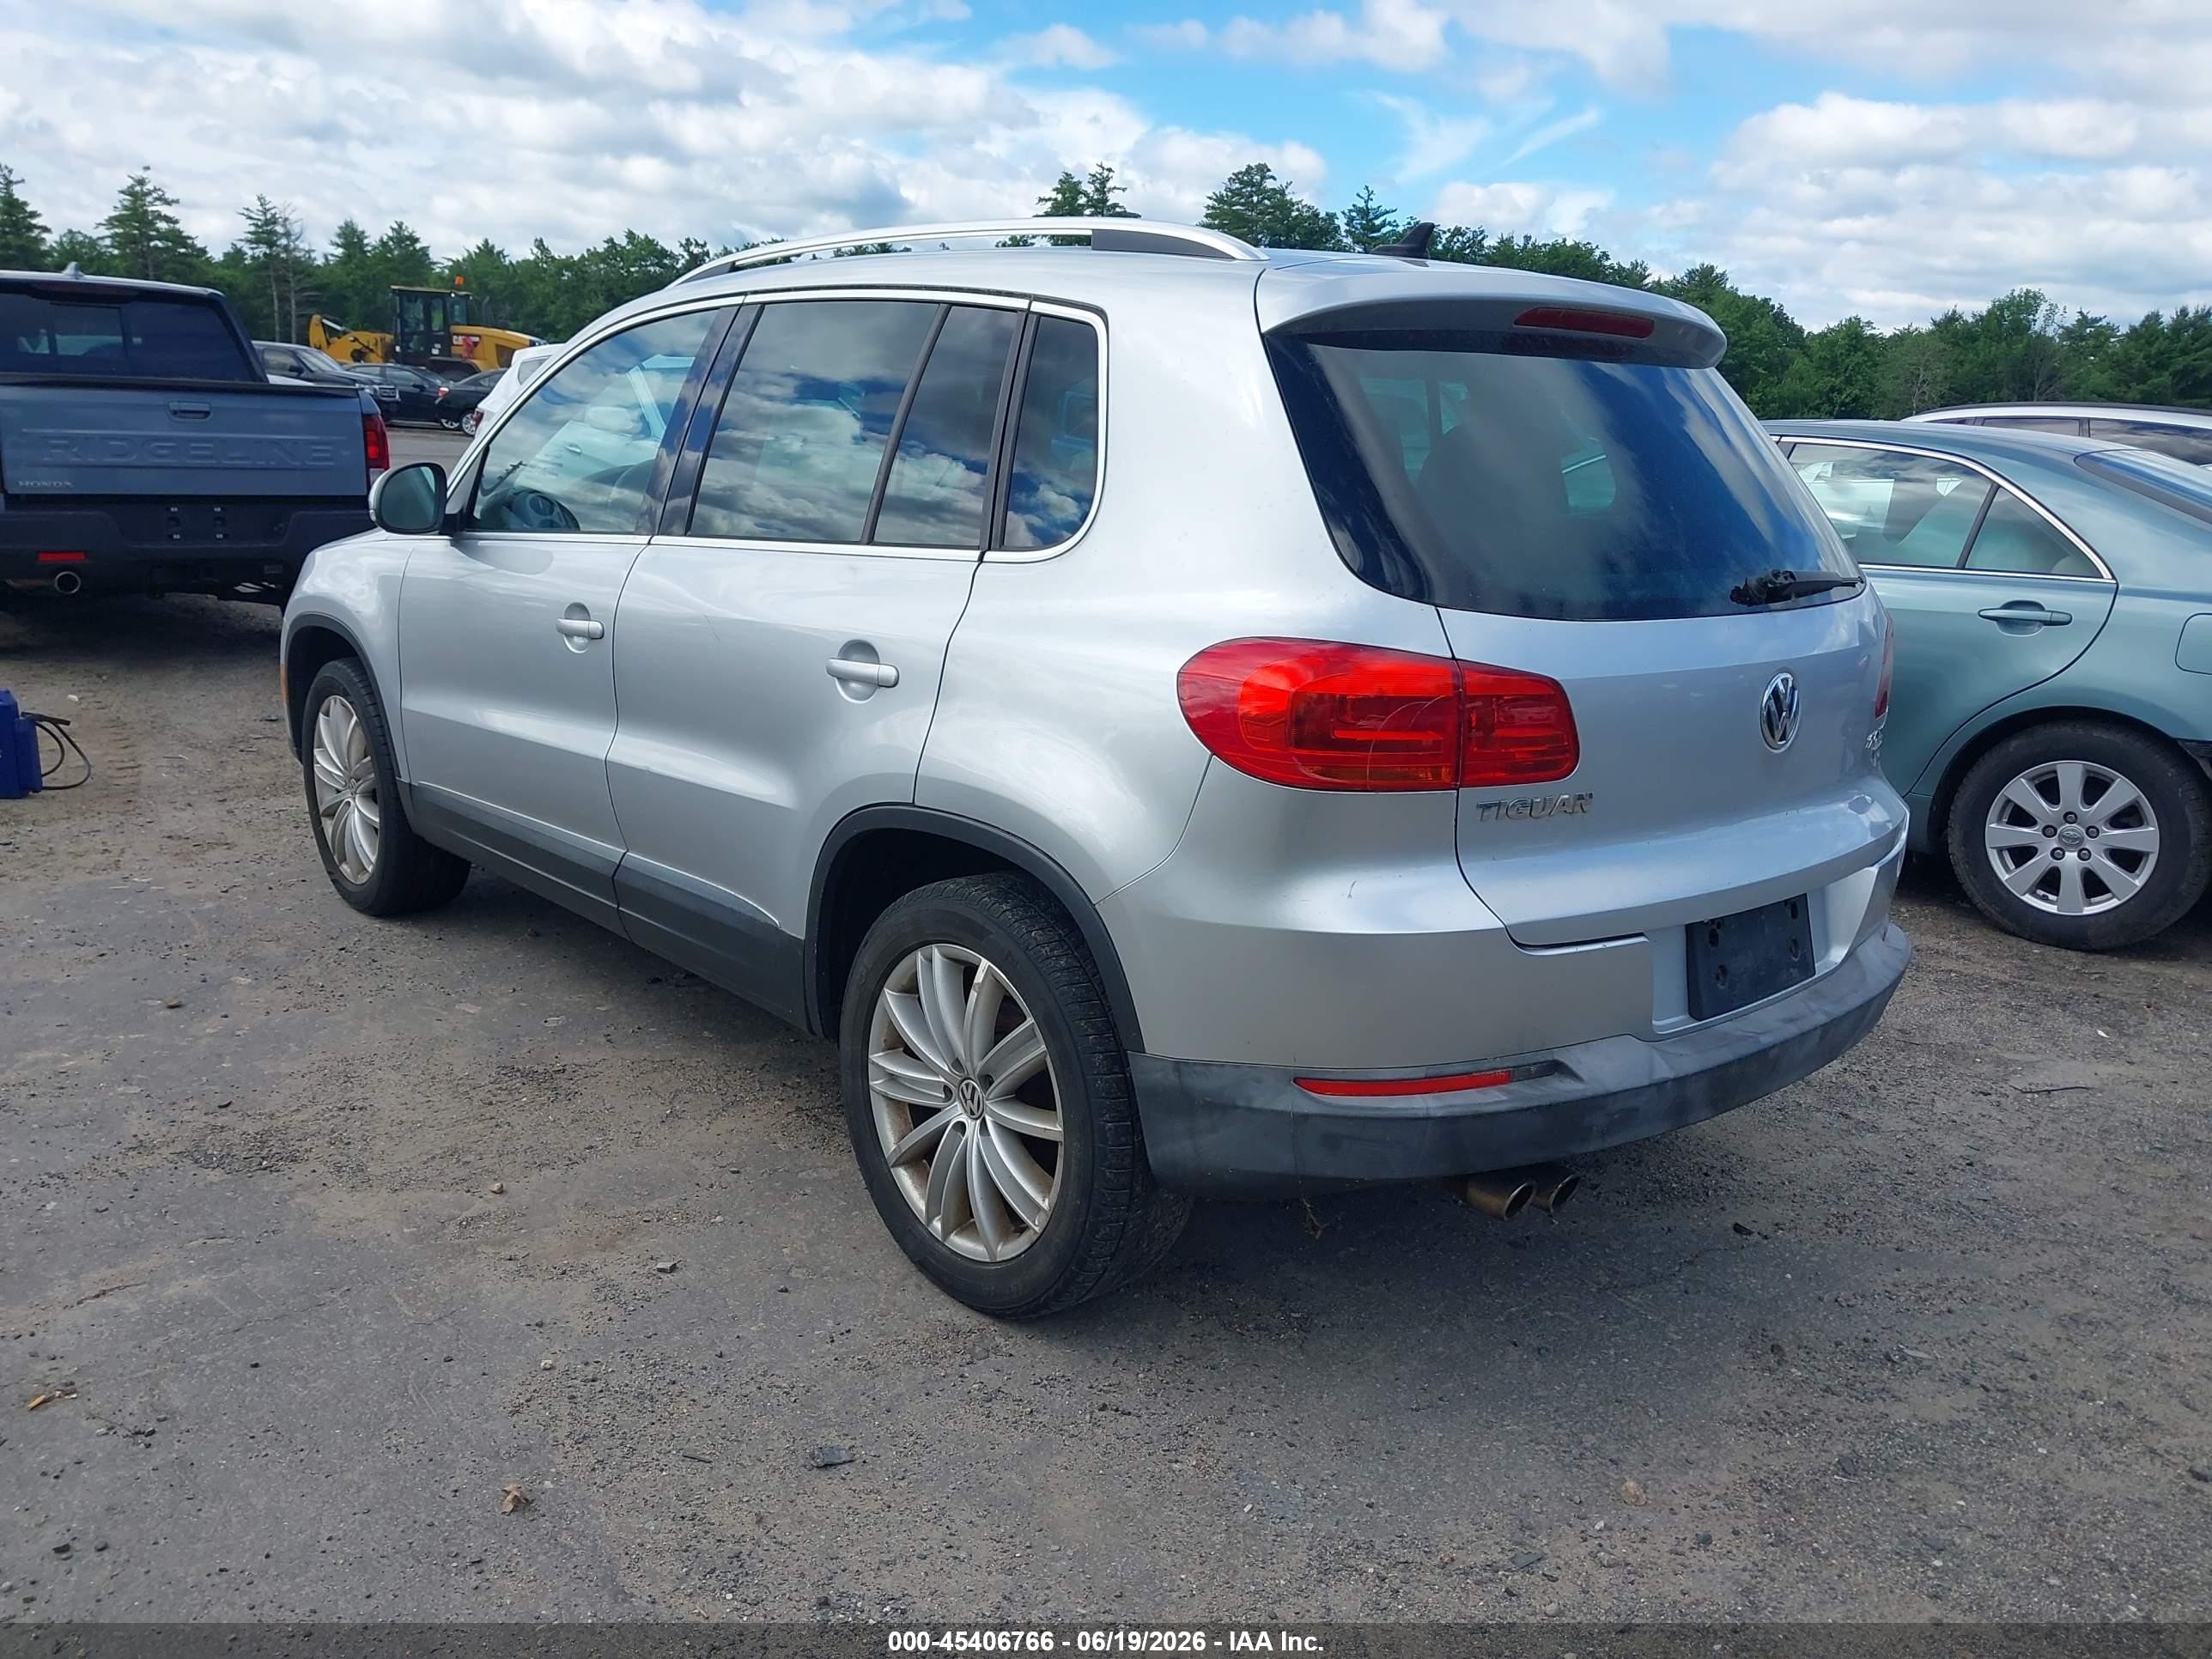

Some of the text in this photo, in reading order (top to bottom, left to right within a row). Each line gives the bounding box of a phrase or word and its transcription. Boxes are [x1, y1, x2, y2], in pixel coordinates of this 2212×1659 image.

[41, 436, 337, 466] RIDGELINE
[17, 480, 75, 489] HONDA
[1476, 792, 1595, 822] TIGUAN
